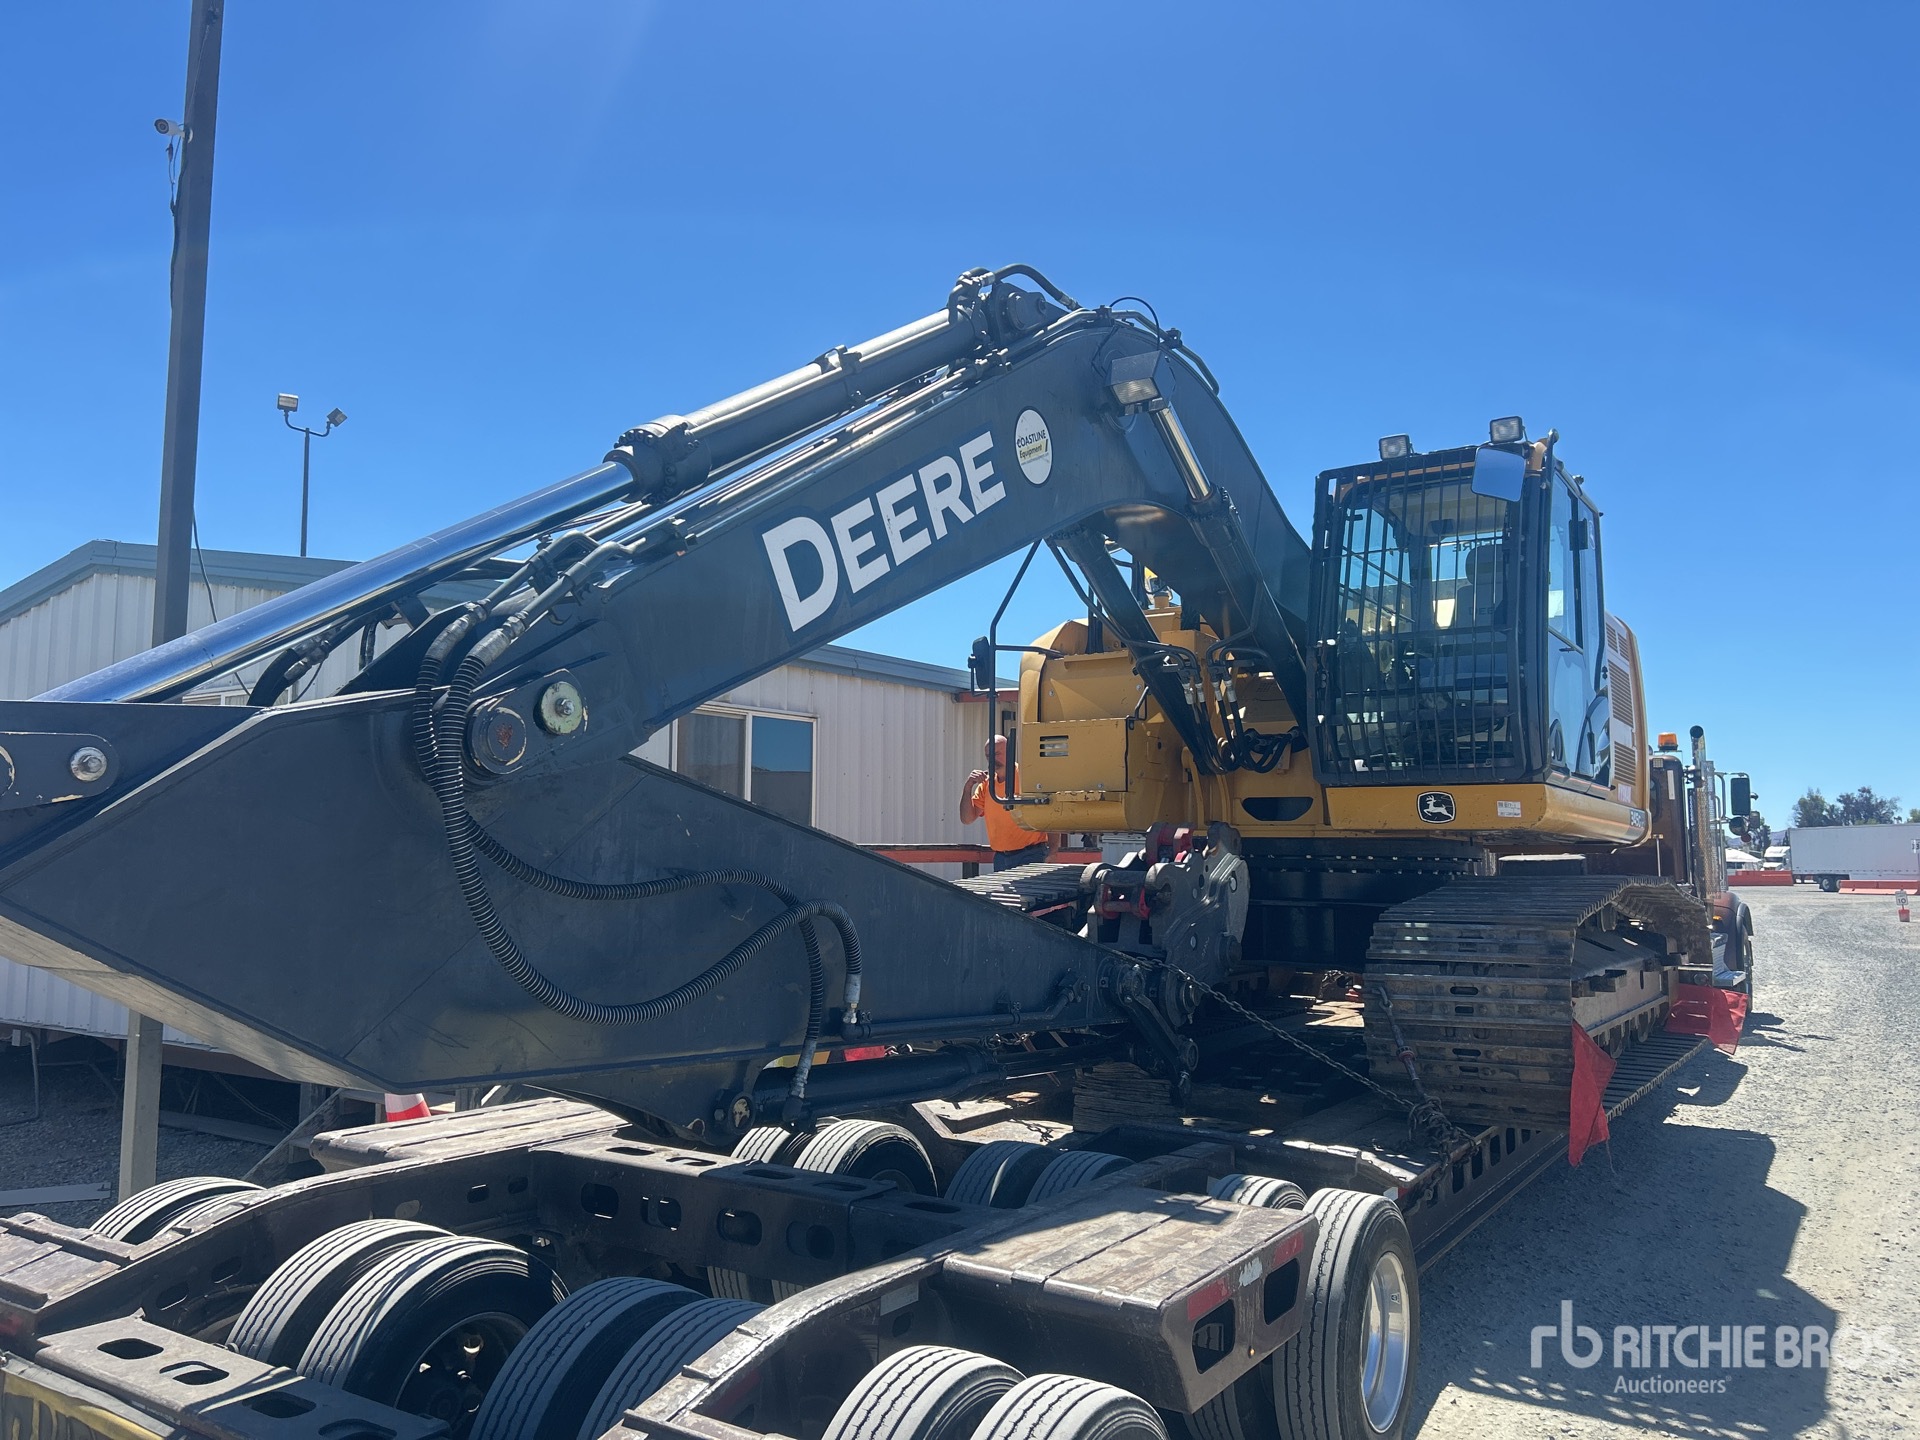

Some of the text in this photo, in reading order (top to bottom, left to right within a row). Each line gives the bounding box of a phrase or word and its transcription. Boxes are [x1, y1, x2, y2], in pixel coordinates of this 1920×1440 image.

[1016, 429, 1047, 448] COASTLINE
[1019, 444, 1043, 460] Equipment
[762, 431, 1006, 632] DEERE
